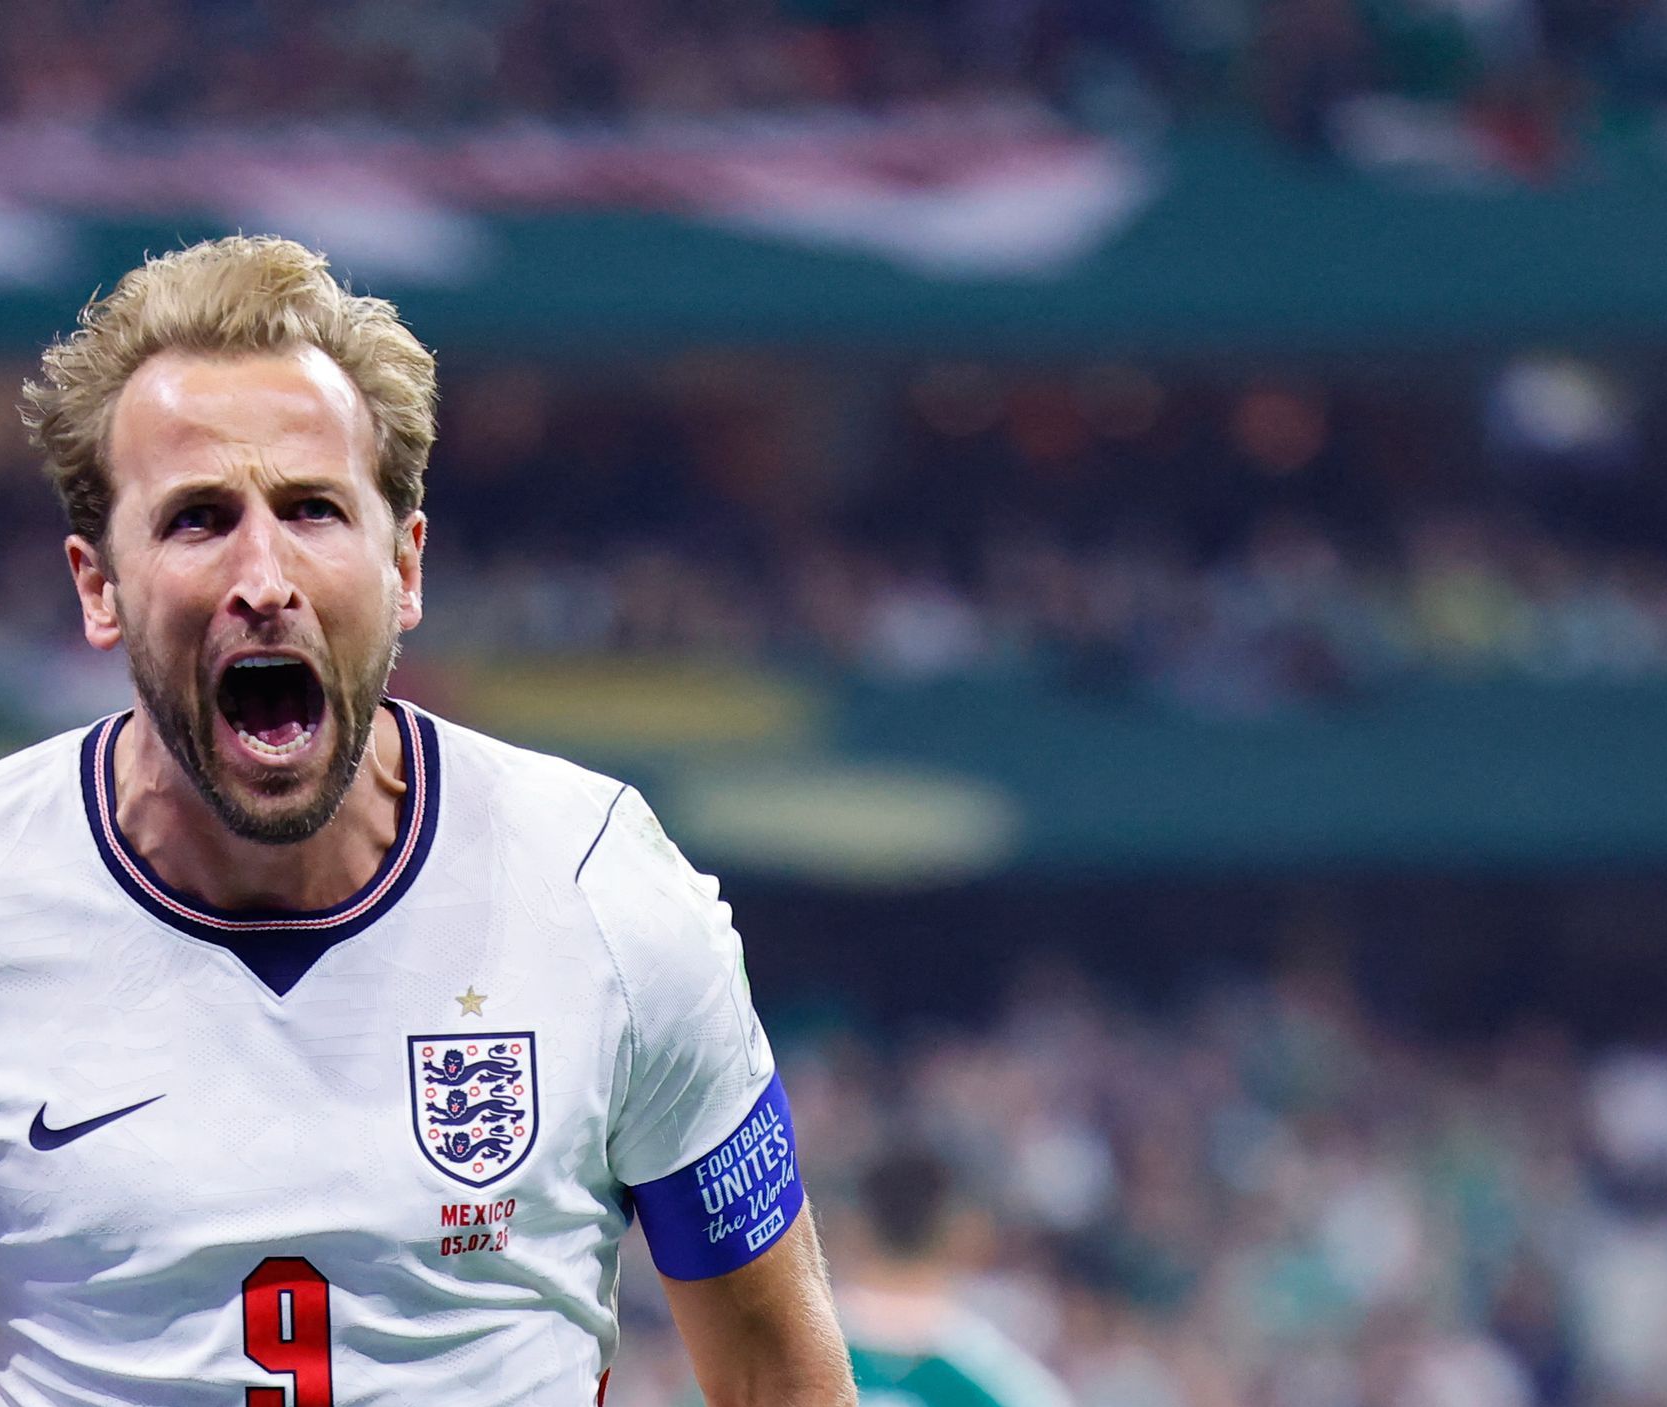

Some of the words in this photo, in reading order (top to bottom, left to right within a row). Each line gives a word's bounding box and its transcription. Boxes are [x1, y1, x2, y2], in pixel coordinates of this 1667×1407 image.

[695, 1102, 780, 1186] FOOTBALL
[700, 1123, 789, 1215] UNITES
[440, 1198, 516, 1227] MEXICO
[702, 1214, 747, 1244] the
[747, 1150, 796, 1221] World
[749, 1212, 782, 1247] FIFA
